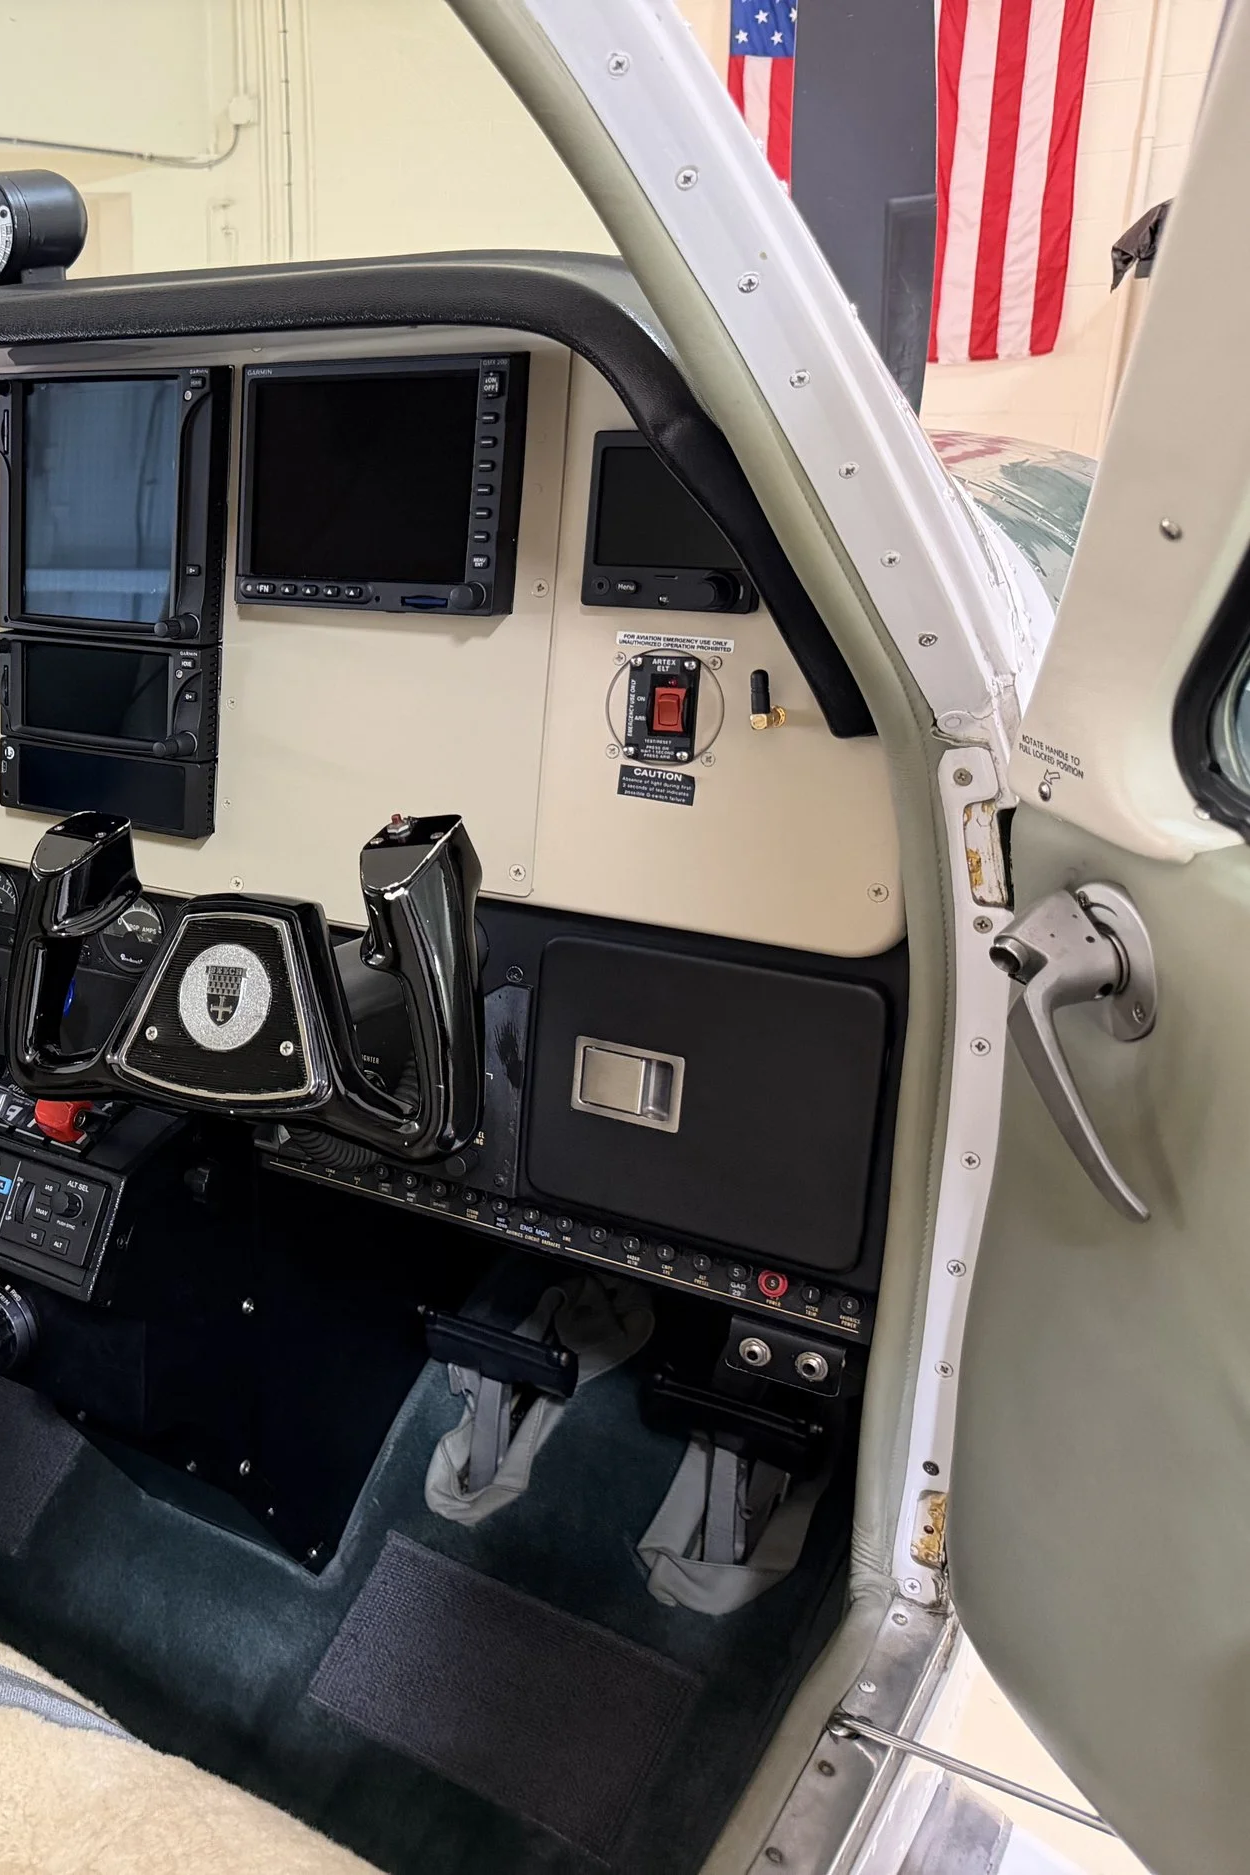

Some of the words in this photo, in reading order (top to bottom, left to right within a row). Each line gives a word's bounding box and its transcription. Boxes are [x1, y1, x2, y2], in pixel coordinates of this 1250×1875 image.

[259, 584, 269, 592] FN
[618, 583, 635, 591] Menu
[619, 640, 661, 648] UNAUTHORIZED
[663, 636, 698, 644] EMERGENCY
[1022, 734, 1043, 750] ROTATE
[1045, 745, 1068, 761] HANDLE
[1071, 756, 1080, 766] TO
[1019, 743, 1031, 755] FULL
[1033, 748, 1055, 765] LOCKED
[1056, 759, 1084, 779] POSITION
[634, 768, 682, 781] CAUTION
[210, 966, 243, 977] BEECH
[407, 1176, 412, 1185] 5
[67, 1180, 78, 1189] ALT
[79, 1183, 89, 1193] SEL
[36, 1207, 48, 1216] VNAV
[520, 1224, 533, 1233] ENG
[535, 1228, 550, 1238] MON
[595, 1230, 600, 1238] 2
[734, 1268, 739, 1277] 5
[730, 1282, 746, 1290] GAD
[847, 1301, 852, 1309] 5
[840, 1314, 860, 1325] AVIONICS
[841, 1320, 857, 1329] POWER
